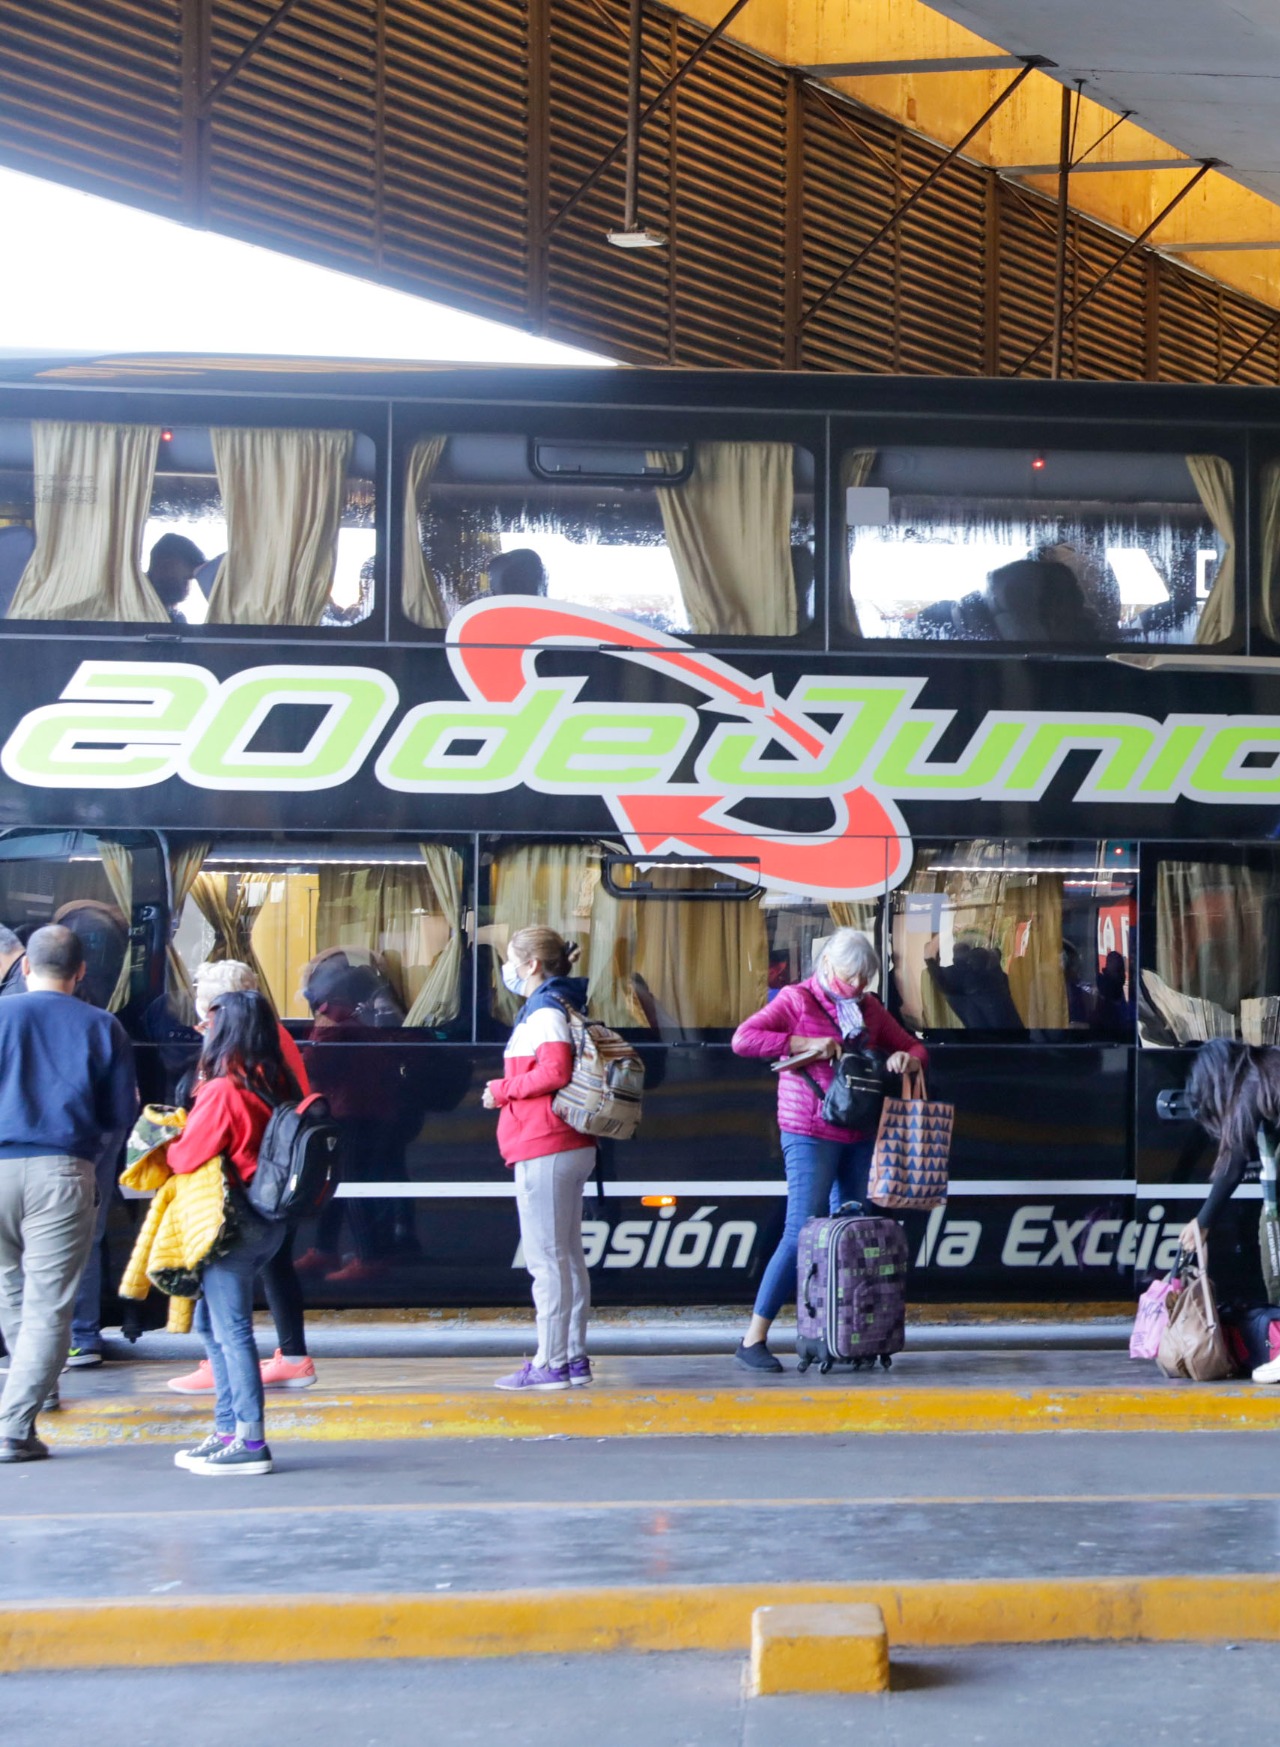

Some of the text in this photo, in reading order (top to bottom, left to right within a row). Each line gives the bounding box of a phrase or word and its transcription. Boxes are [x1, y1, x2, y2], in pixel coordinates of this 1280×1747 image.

[0, 660, 400, 791] 20
[375, 676, 700, 794] de
[511, 1206, 757, 1268] asión
[915, 1205, 982, 1268] la
